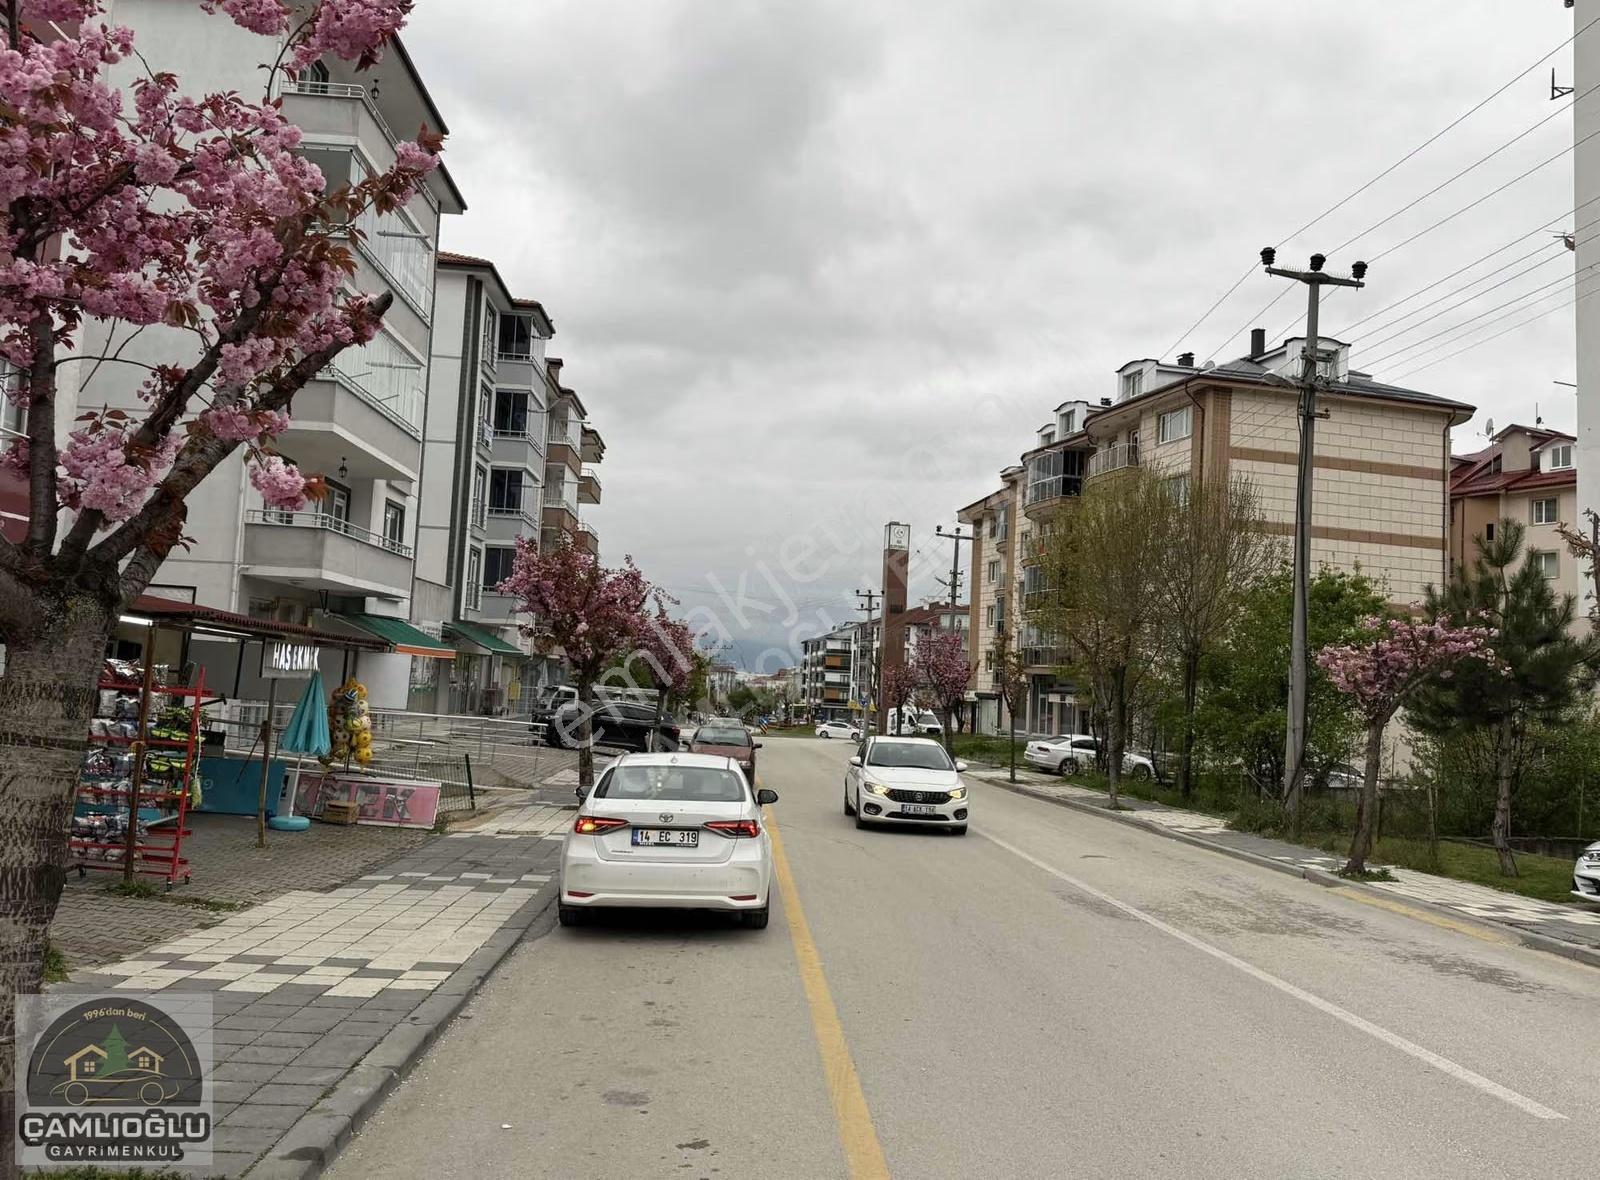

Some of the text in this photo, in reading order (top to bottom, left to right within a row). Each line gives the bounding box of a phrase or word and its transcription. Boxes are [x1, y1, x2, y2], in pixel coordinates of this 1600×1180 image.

[272, 641, 292, 671] HAS
[639, 830, 697, 843] 14 EC 319
